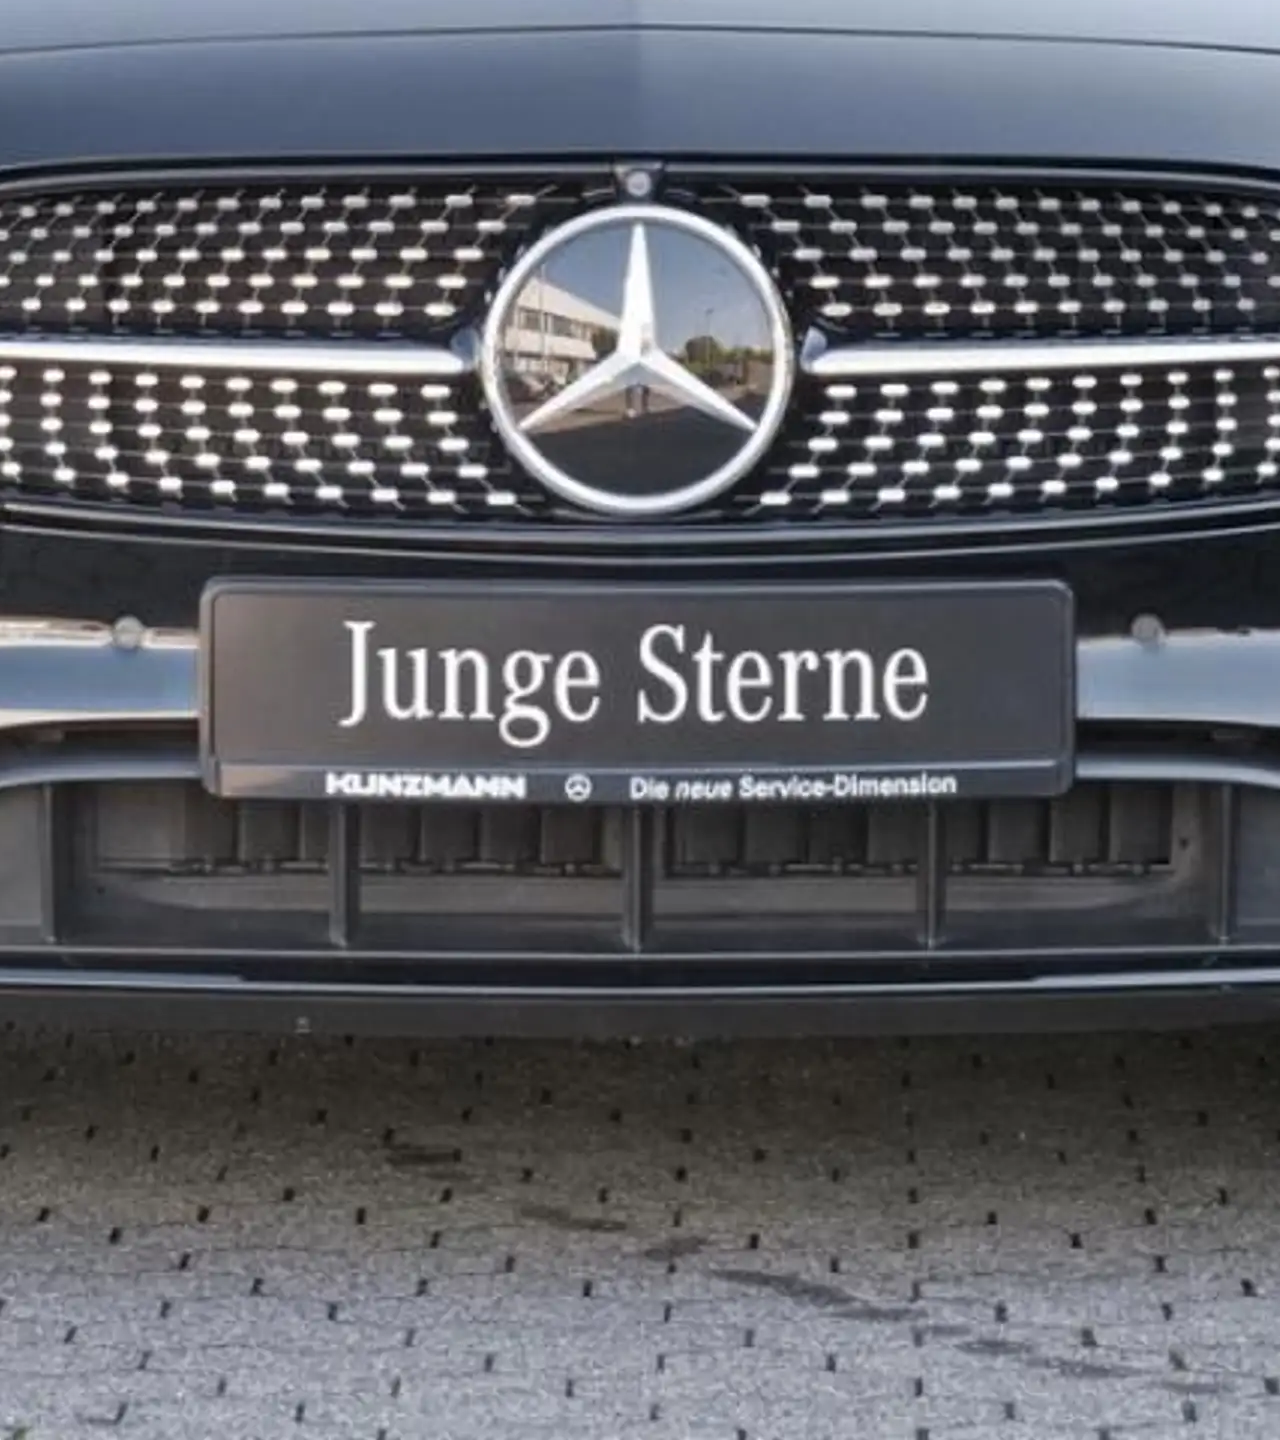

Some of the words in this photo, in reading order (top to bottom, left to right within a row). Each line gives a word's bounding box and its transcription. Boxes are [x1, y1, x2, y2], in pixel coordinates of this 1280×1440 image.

[339, 620, 600, 748] Junge
[637, 623, 930, 724] Sterne
[325, 772, 527, 799] KUNZMANN
[629, 776, 669, 800] Die
[674, 779, 732, 800] neue
[738, 772, 958, 800] Service-Dimension
